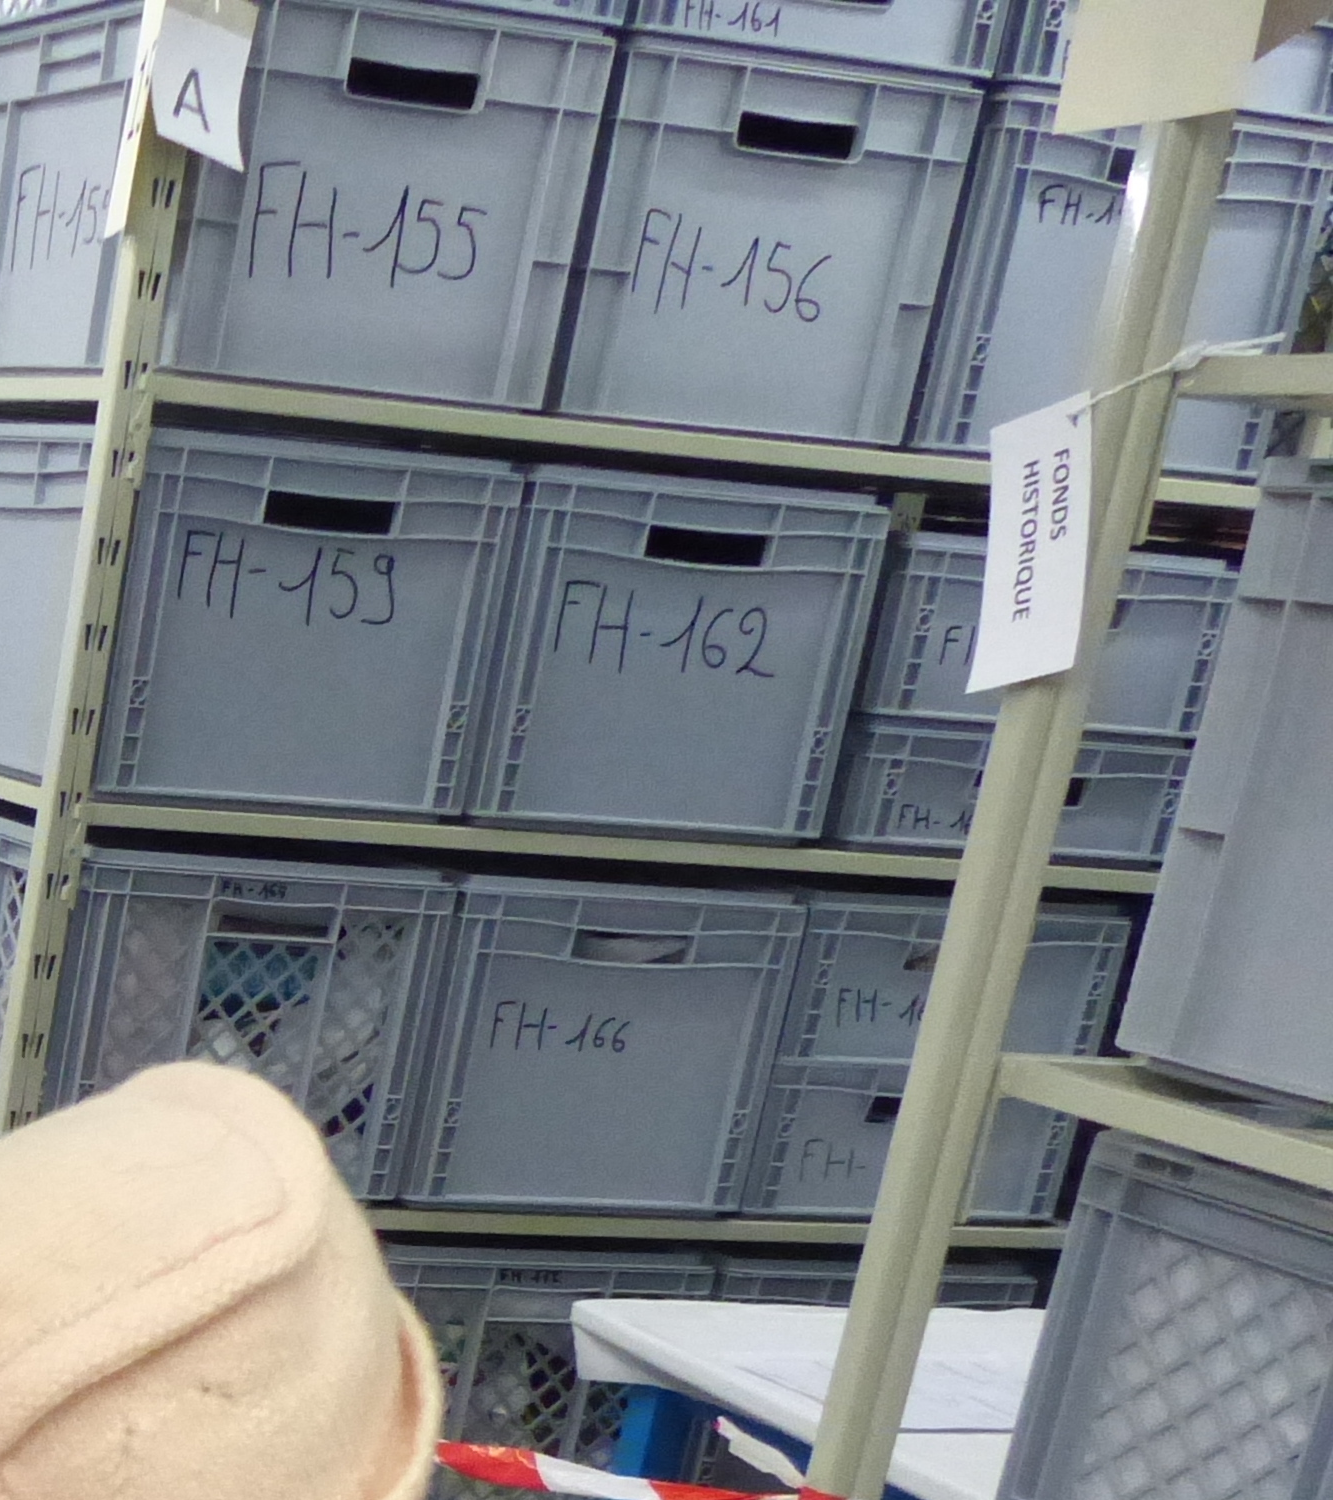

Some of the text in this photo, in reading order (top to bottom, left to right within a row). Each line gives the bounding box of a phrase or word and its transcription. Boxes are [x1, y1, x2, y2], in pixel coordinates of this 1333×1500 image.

[173, 67, 210, 134] A
[247, 160, 485, 288] FH-155
[1038, 184, 1123, 226] FH-1
[630, 209, 832, 323] FH-156
[1011, 460, 1041, 623] HISTORIQUE
[1050, 448, 1070, 542] FONDS
[177, 530, 395, 627] FH-159
[554, 580, 776, 678] FH-162
[490, 1000, 631, 1053] FH-166
